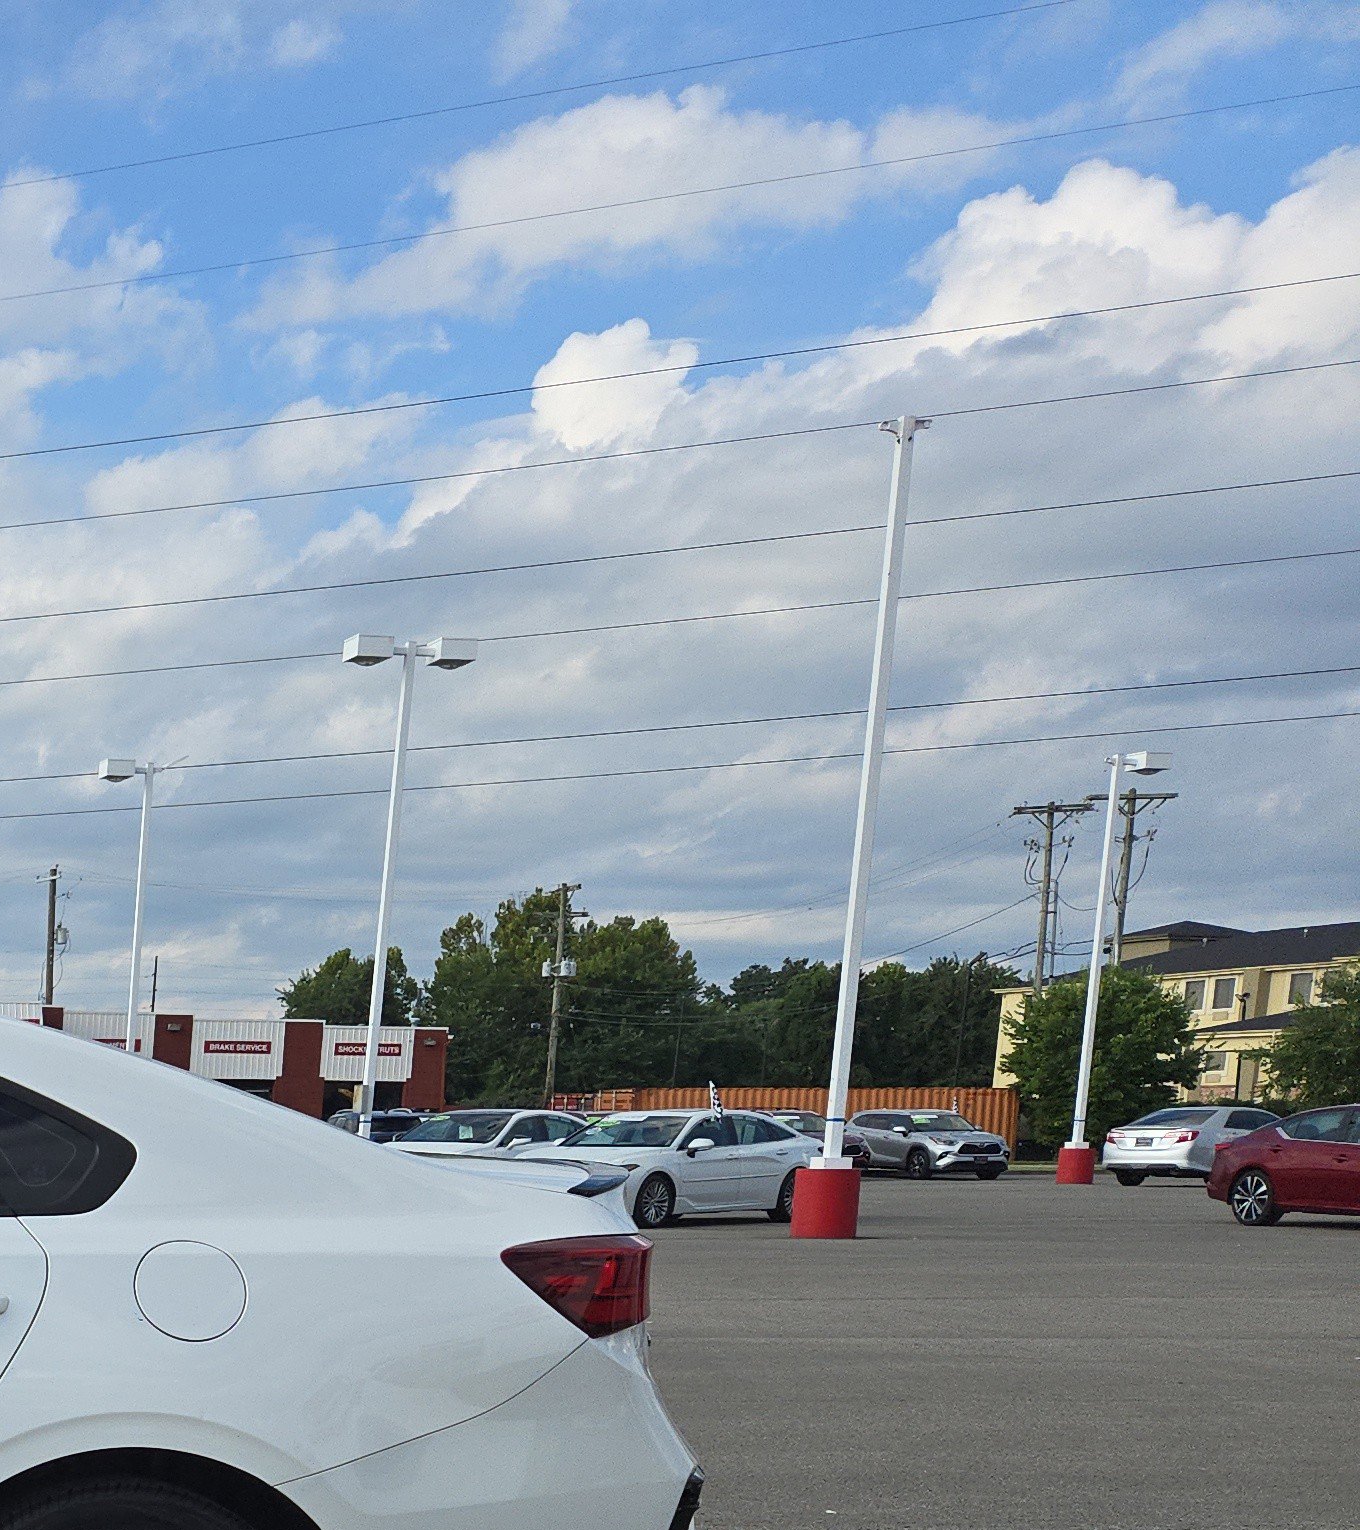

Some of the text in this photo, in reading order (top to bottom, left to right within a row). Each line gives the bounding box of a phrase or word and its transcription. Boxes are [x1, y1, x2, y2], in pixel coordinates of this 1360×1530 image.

[209, 1043, 268, 1053] BRAKE SERVICE
[337, 1045, 400, 1055] SHOCK RUTS
